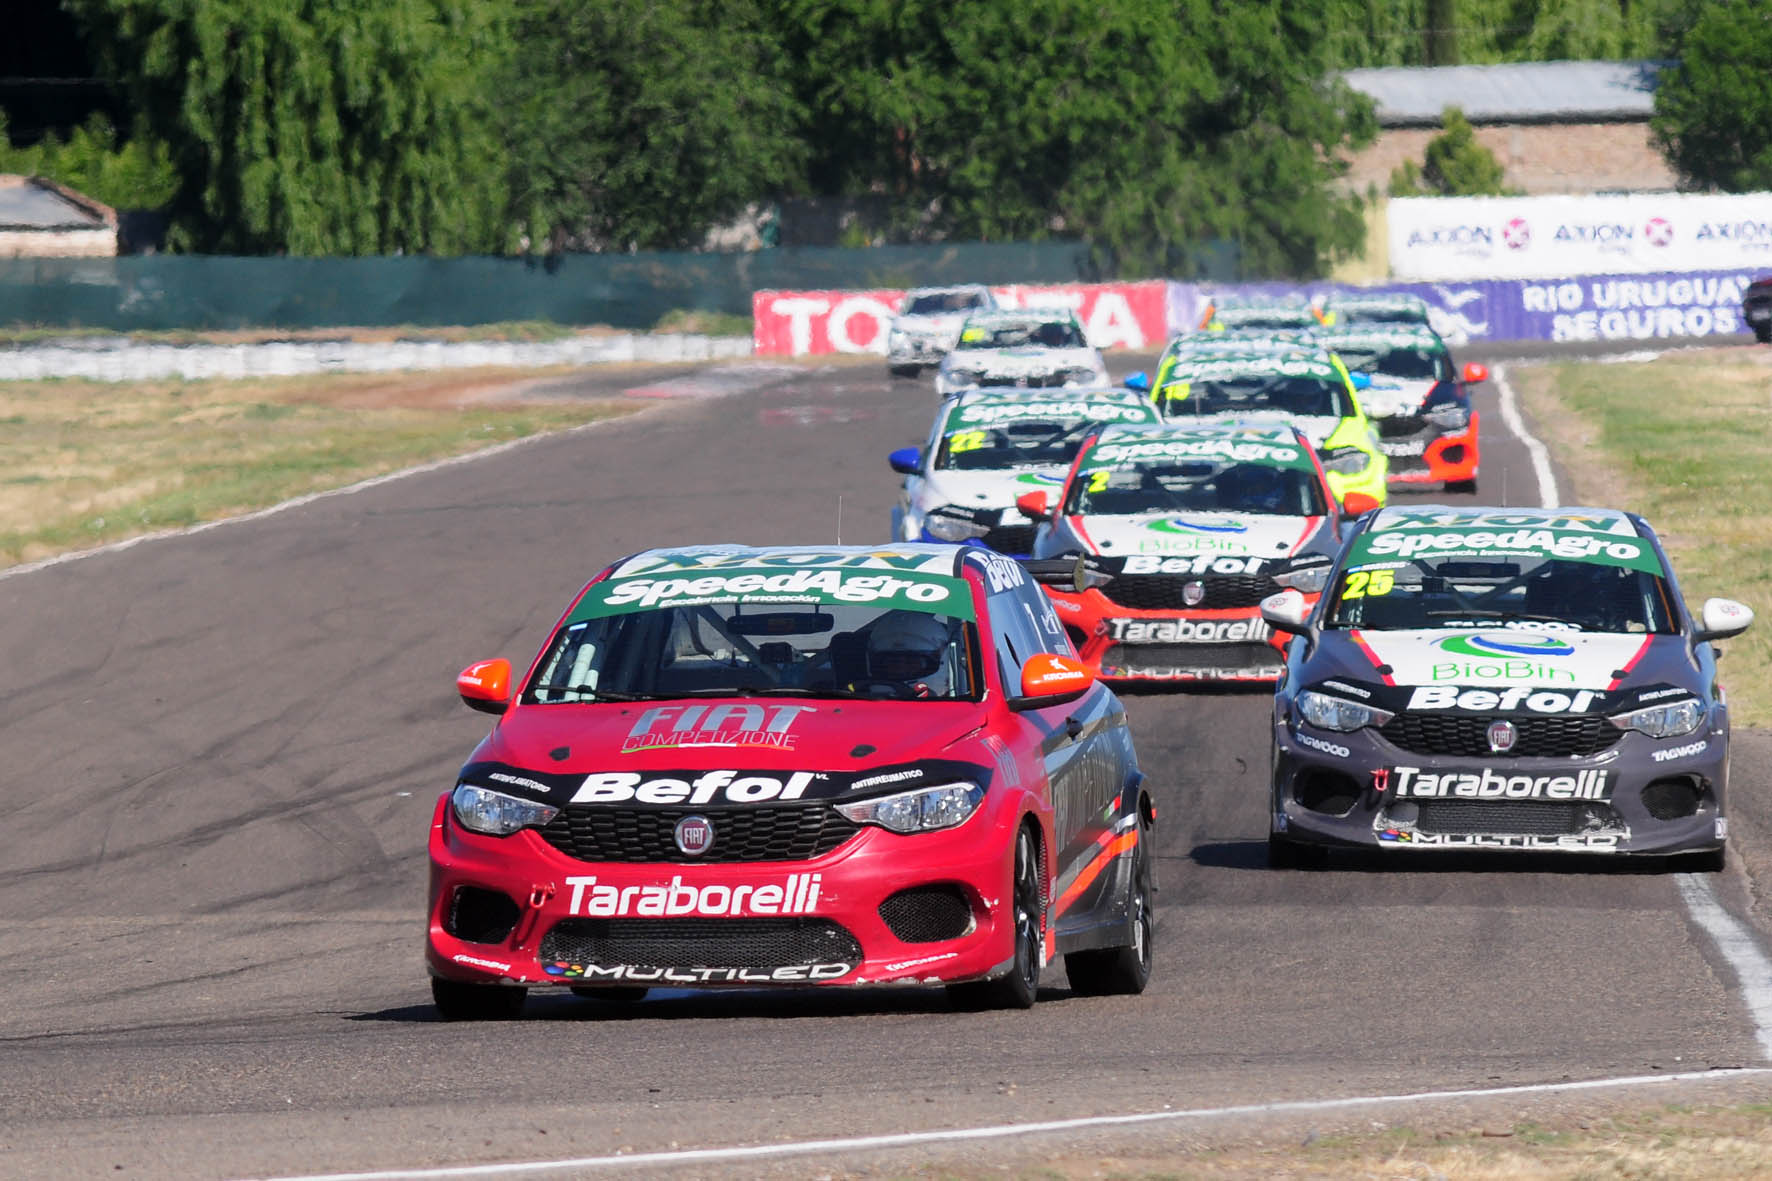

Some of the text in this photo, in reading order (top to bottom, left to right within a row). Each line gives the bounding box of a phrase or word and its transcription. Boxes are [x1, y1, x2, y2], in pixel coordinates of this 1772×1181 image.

[1522, 284, 1584, 312] RIO
[771, 292, 1147, 356] TOTA
[1552, 307, 1738, 341] SEGUROS
[959, 402, 1147, 423] SpeedAgro
[1091, 442, 1299, 463] SpeedAgro
[1088, 471, 1111, 493] 2
[1367, 530, 1641, 559] SpeedAgro
[1121, 556, 1263, 576] Befol
[603, 570, 950, 607] SpeedAgro
[1342, 569, 1395, 600] 25
[1432, 661, 1576, 682] BioBin
[1406, 686, 1595, 713] Befol
[627, 703, 818, 738] FIAT
[622, 730, 800, 751] COMPETIZIONE
[1651, 740, 1708, 762] TAGWOOD
[570, 770, 815, 804] Befol
[1394, 766, 1609, 800] Taraborelli
[684, 827, 705, 845] FIAT
[1410, 832, 1618, 847] MULTILED
[565, 873, 823, 916] Taraborelli
[583, 962, 850, 982] MULTILED
